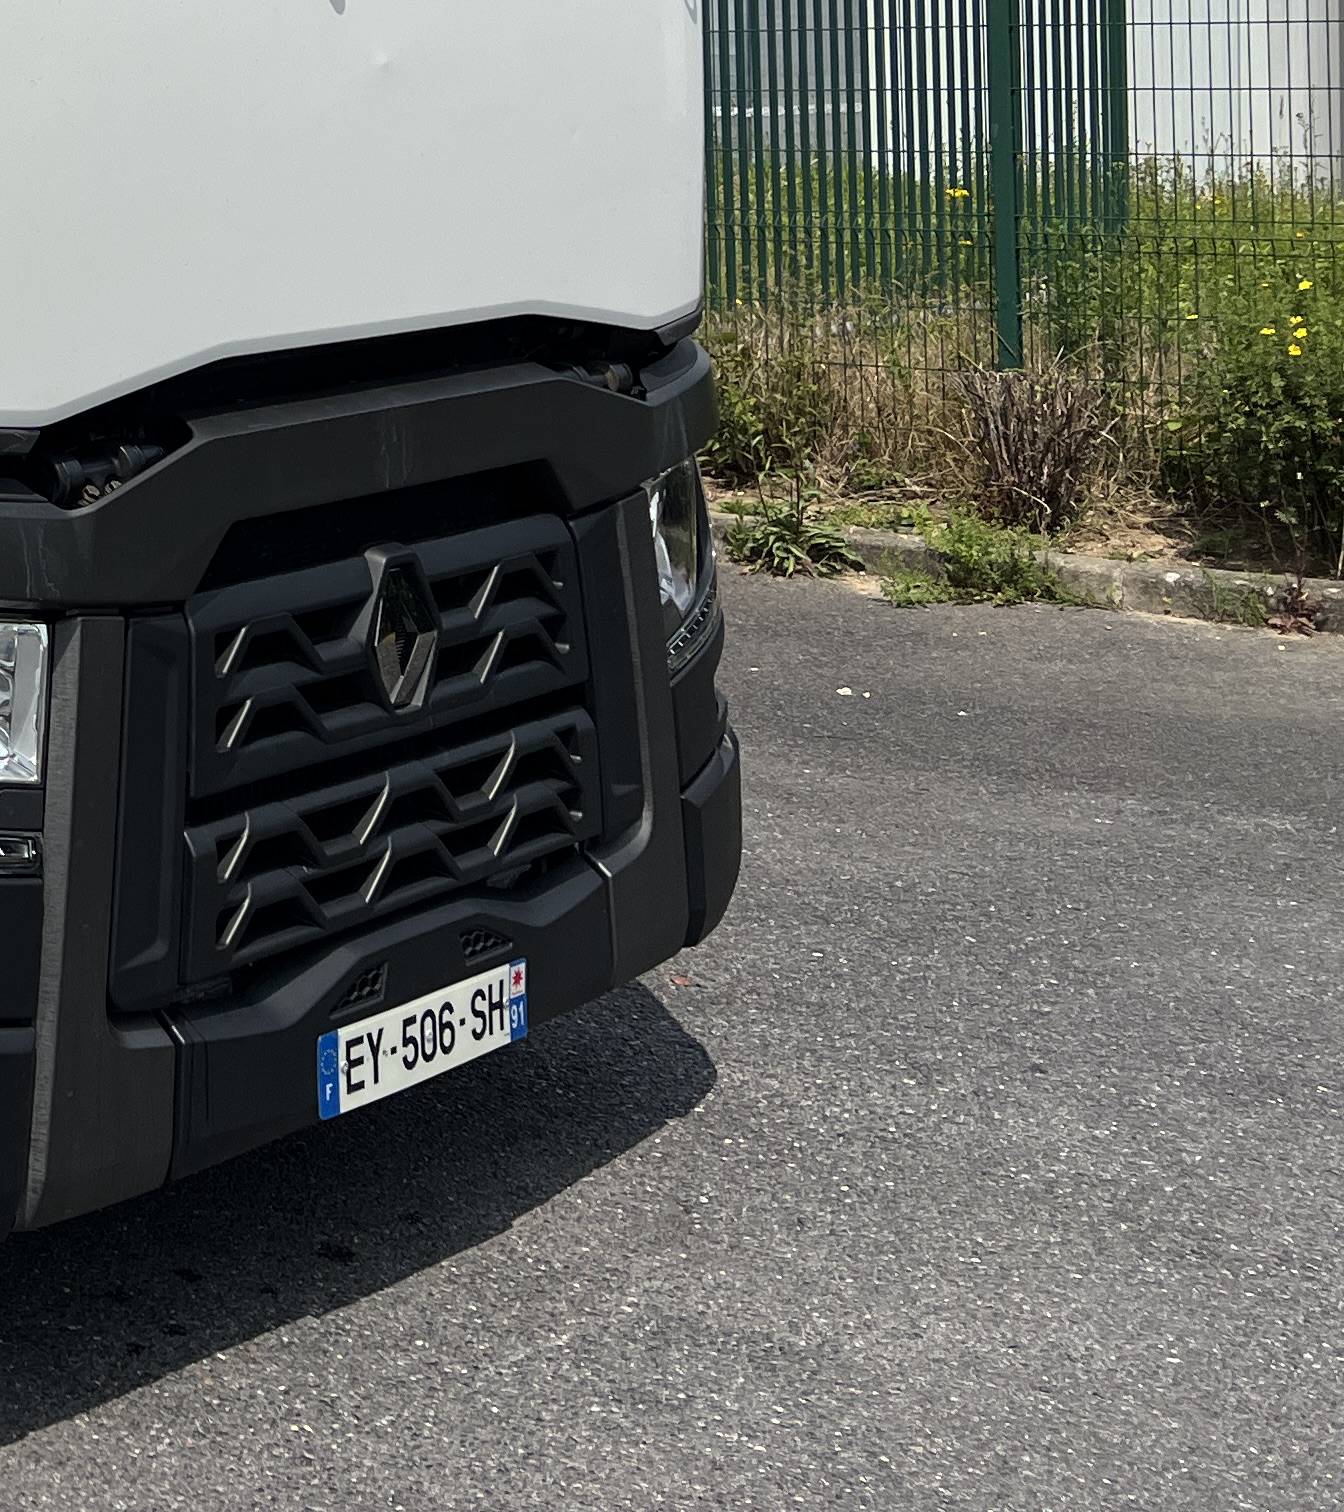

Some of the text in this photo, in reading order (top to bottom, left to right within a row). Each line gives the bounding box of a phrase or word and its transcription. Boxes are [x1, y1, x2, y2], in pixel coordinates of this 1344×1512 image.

[510, 1000, 525, 1029] 91
[344, 979, 506, 1096] EY-506-SH
[325, 1082, 334, 1102] F
